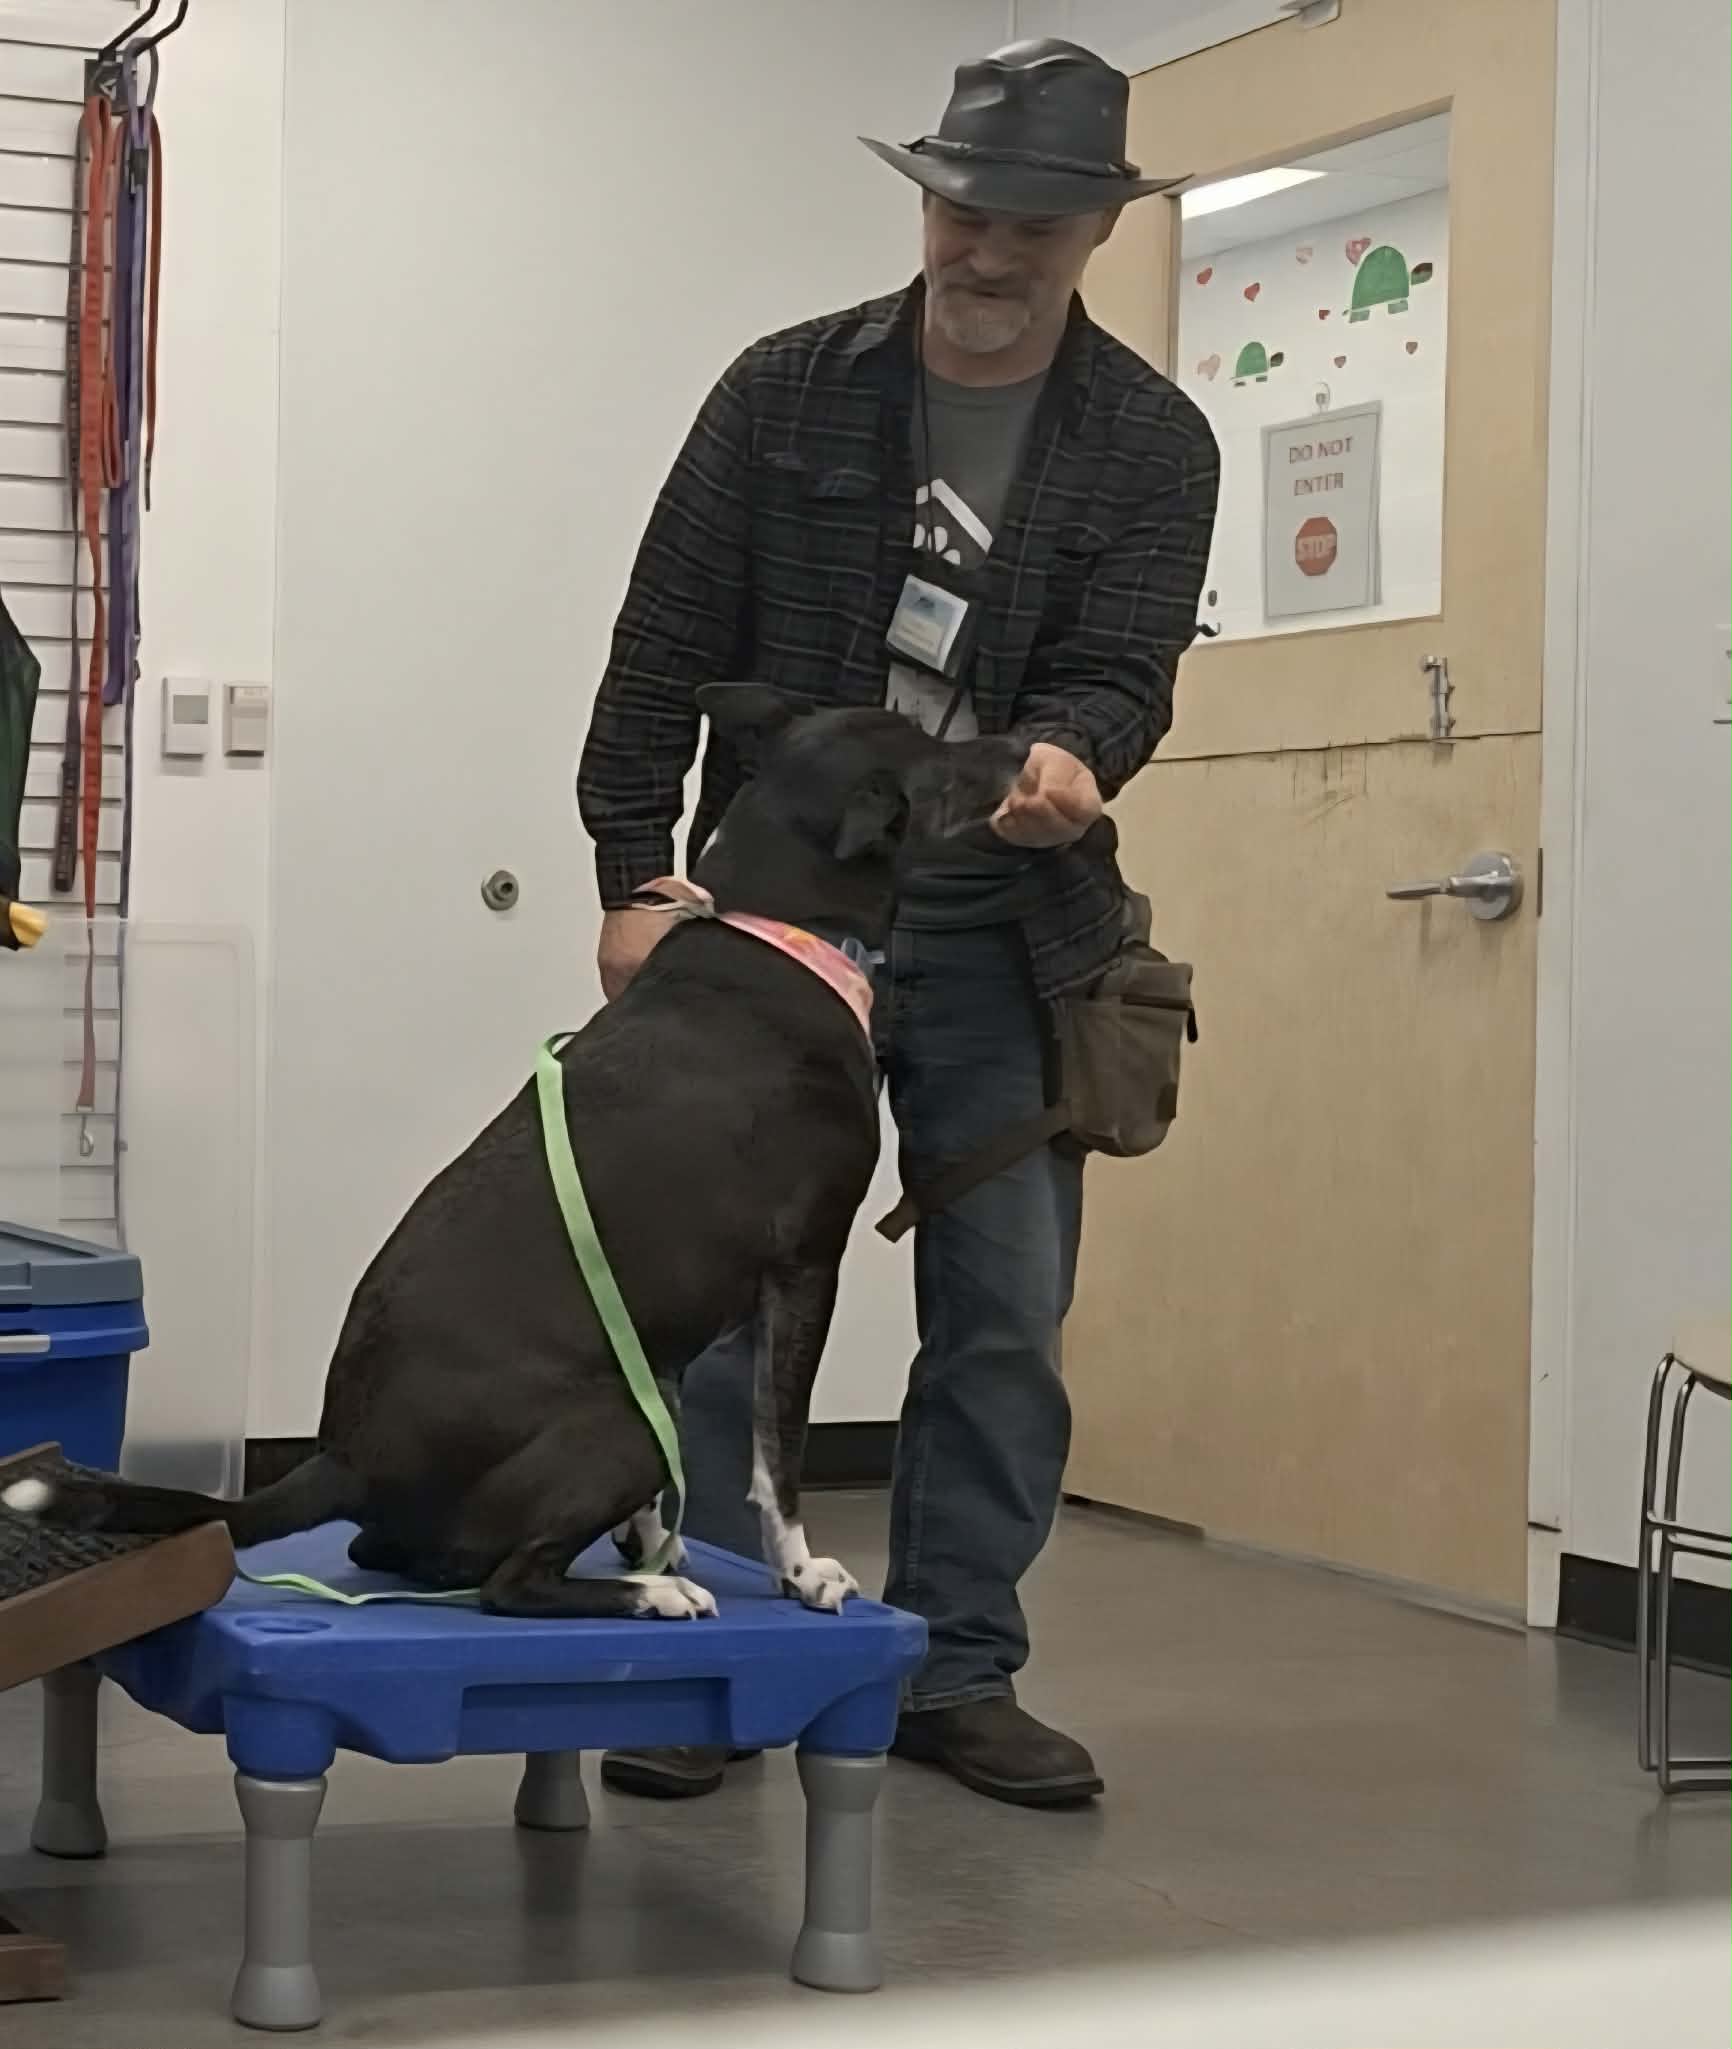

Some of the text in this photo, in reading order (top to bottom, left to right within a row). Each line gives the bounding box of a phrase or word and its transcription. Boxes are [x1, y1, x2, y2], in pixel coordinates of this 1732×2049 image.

[1288, 435, 1354, 465] DO NOT
[1293, 472, 1345, 497] ENTER
[1295, 533, 1337, 561] STOP
